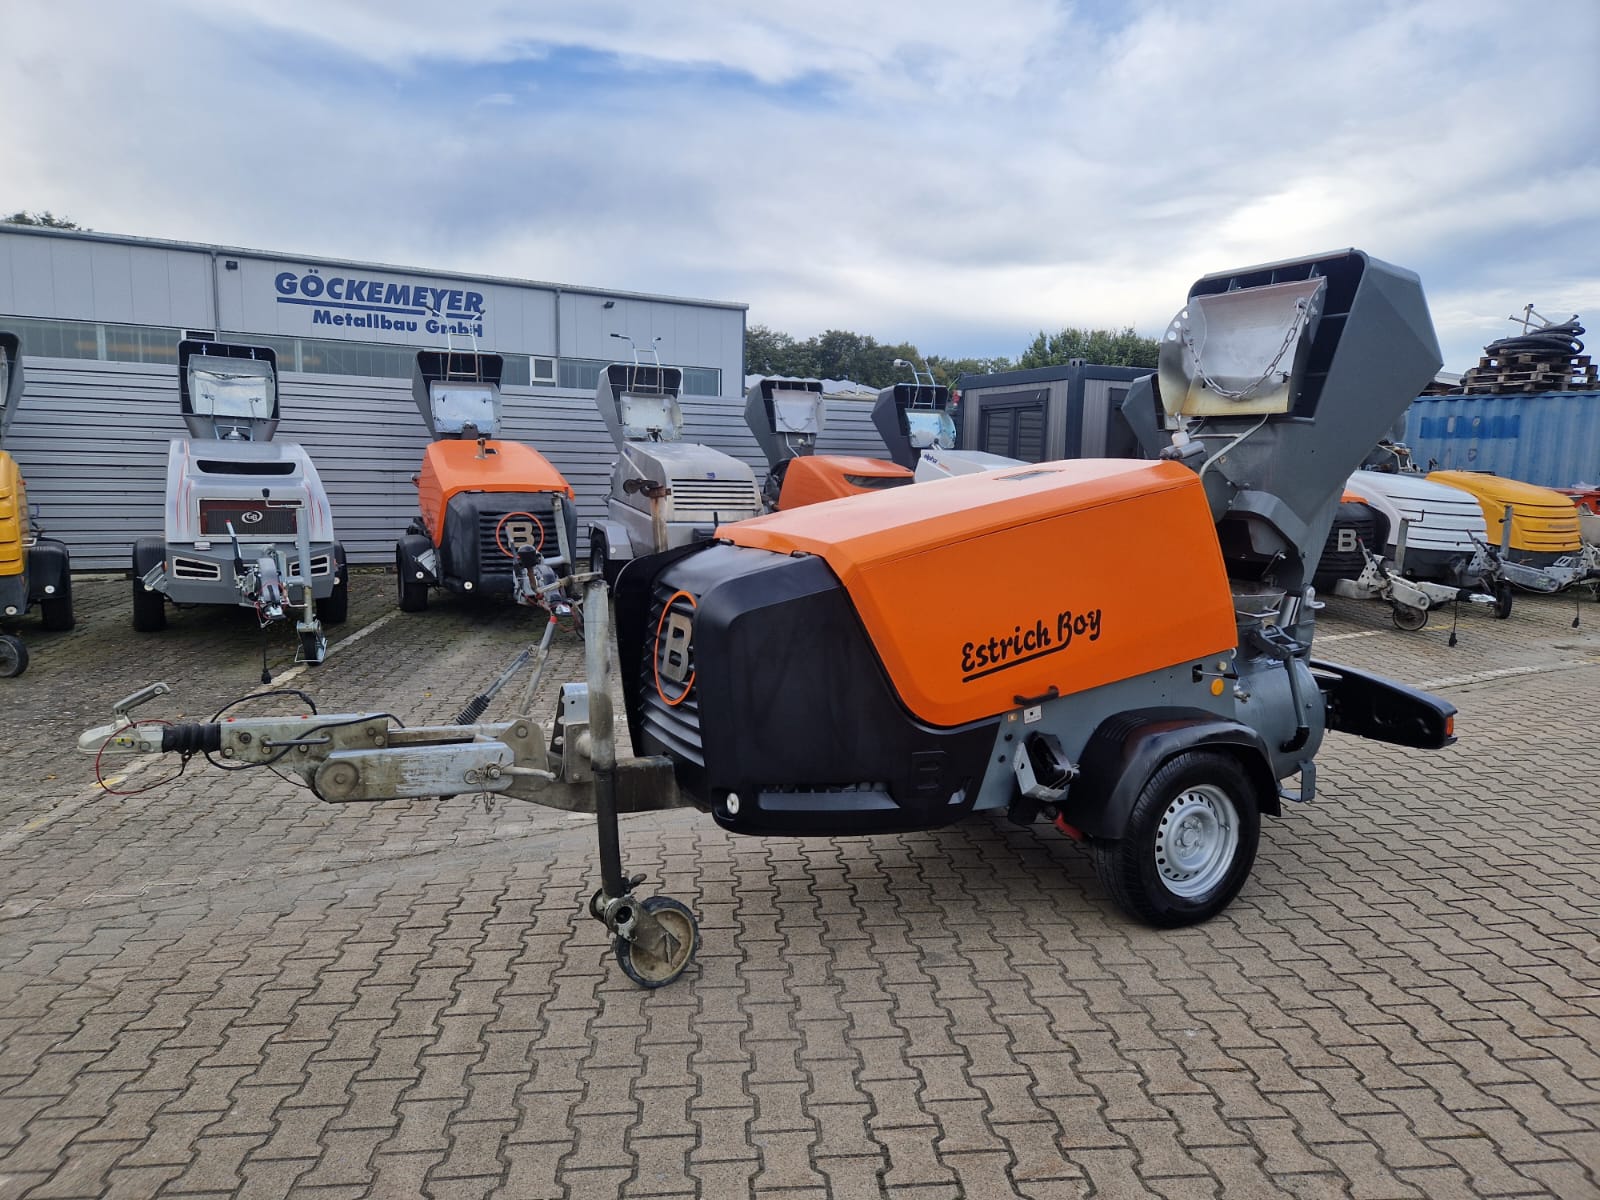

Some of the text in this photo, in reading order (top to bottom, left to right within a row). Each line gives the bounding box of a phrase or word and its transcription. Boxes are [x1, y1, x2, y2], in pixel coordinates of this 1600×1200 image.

[275, 268, 484, 317] GÖCKEMEYER
[313, 310, 483, 338] Metallbau GmbH
[506, 521, 535, 549] B
[1337, 528, 1358, 552] B
[661, 611, 692, 682] B
[961, 608, 1102, 673] Estrich Boy
